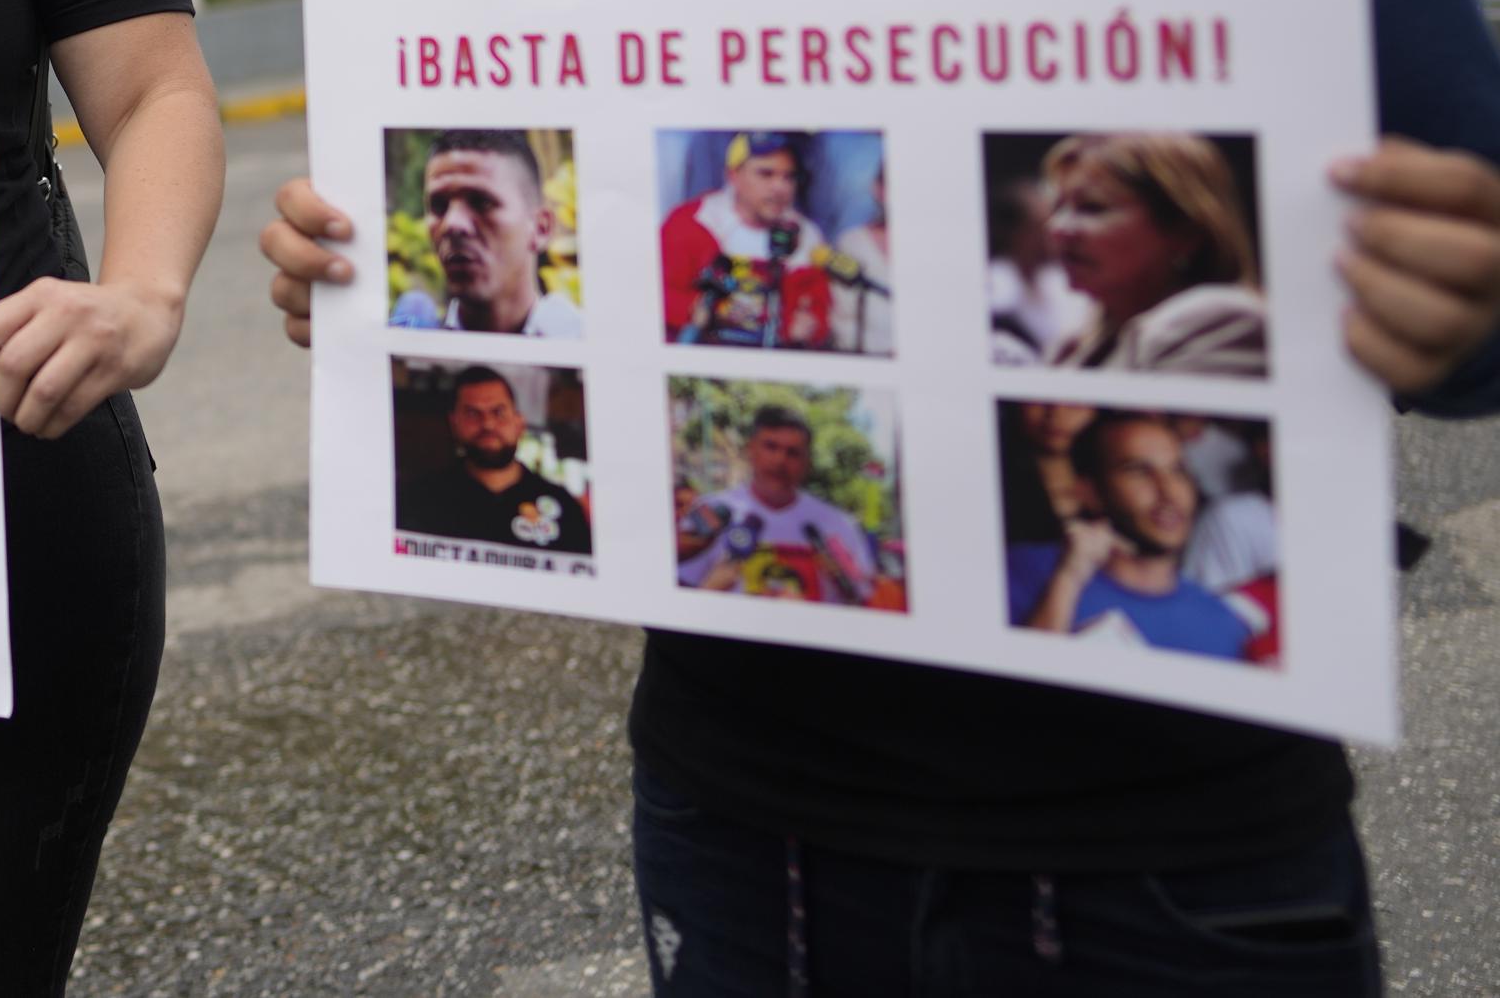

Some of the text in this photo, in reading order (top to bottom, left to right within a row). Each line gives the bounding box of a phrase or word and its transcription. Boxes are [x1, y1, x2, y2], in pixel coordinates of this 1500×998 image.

[397, 5, 1231, 89] ¡BASTA DE PERSECUCIÓN!
